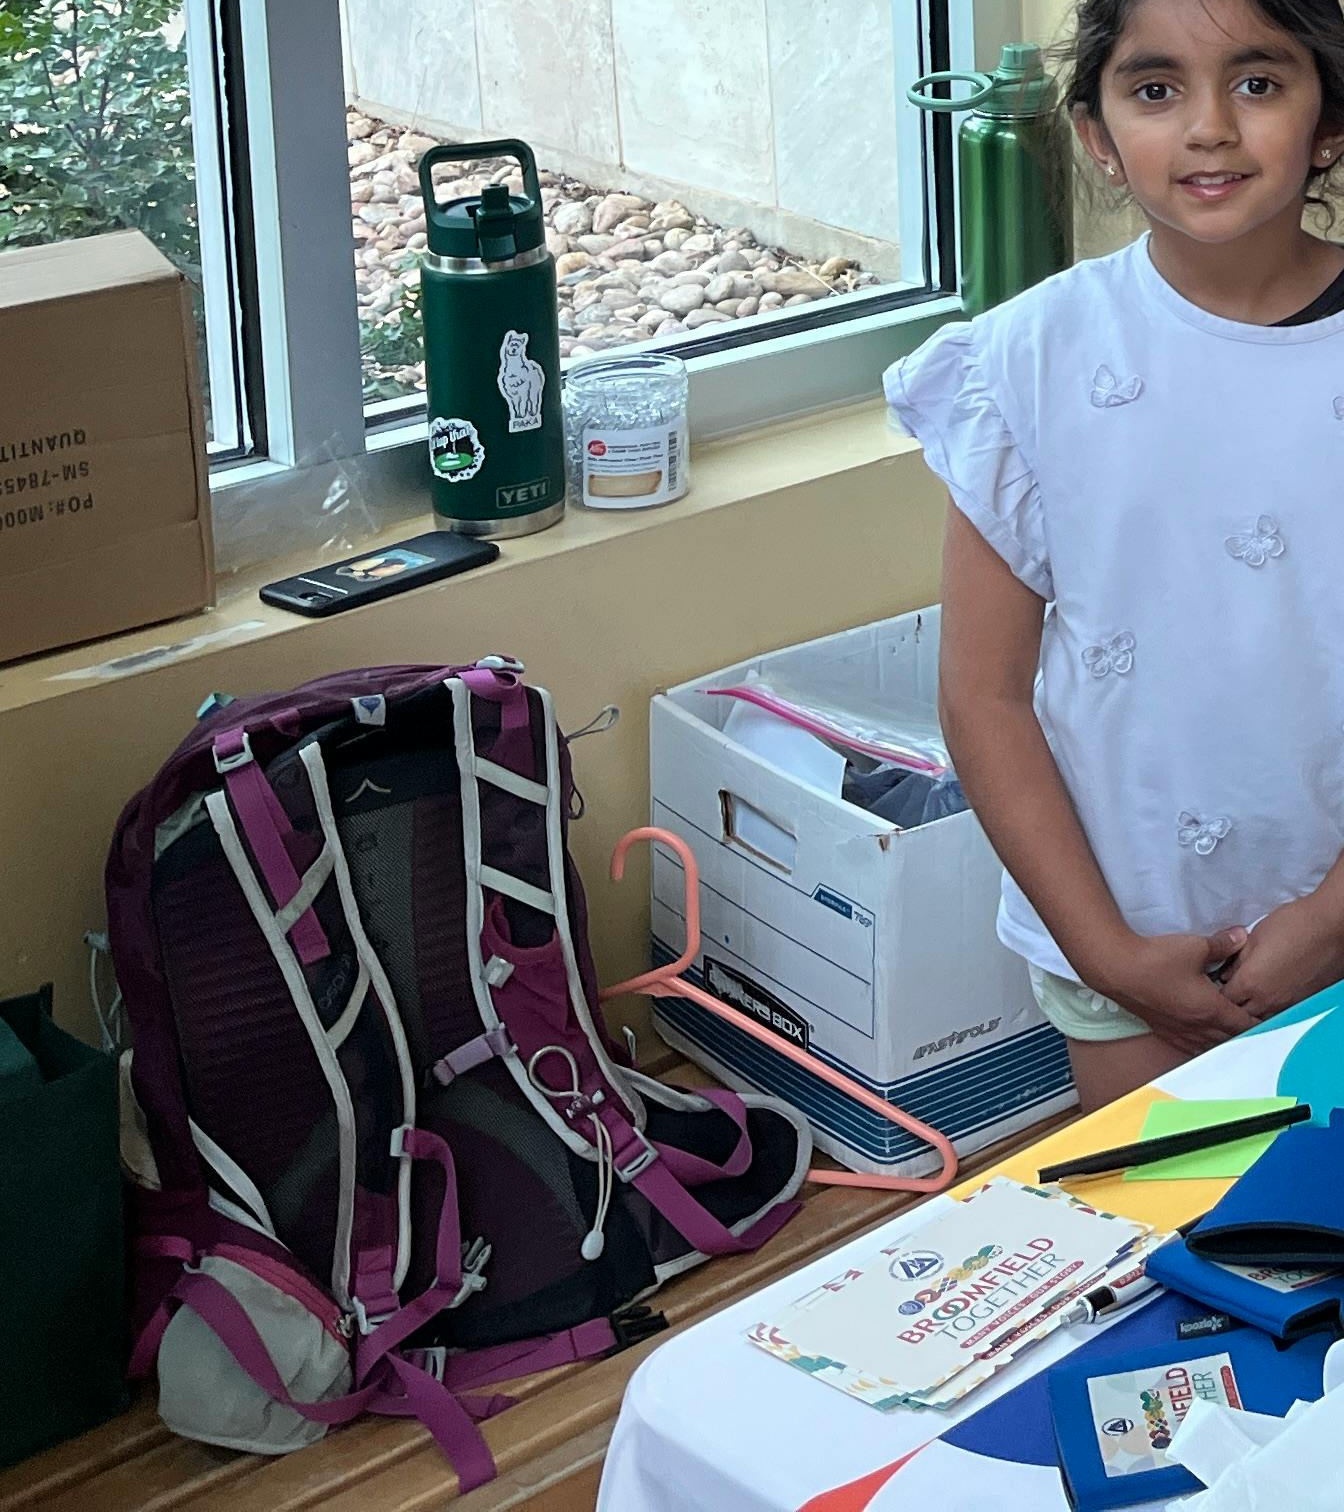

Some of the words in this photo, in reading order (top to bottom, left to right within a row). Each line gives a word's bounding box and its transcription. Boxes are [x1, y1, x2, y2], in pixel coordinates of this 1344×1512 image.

[0, 461, 90, 494] SM-7845
[501, 482, 546, 505] YETI
[0, 507, 45, 530] M00
[772, 1012, 804, 1043] BOX
[897, 1237, 1053, 1344] BROOMFIELD
[934, 1252, 1065, 1339] TOGETHER
